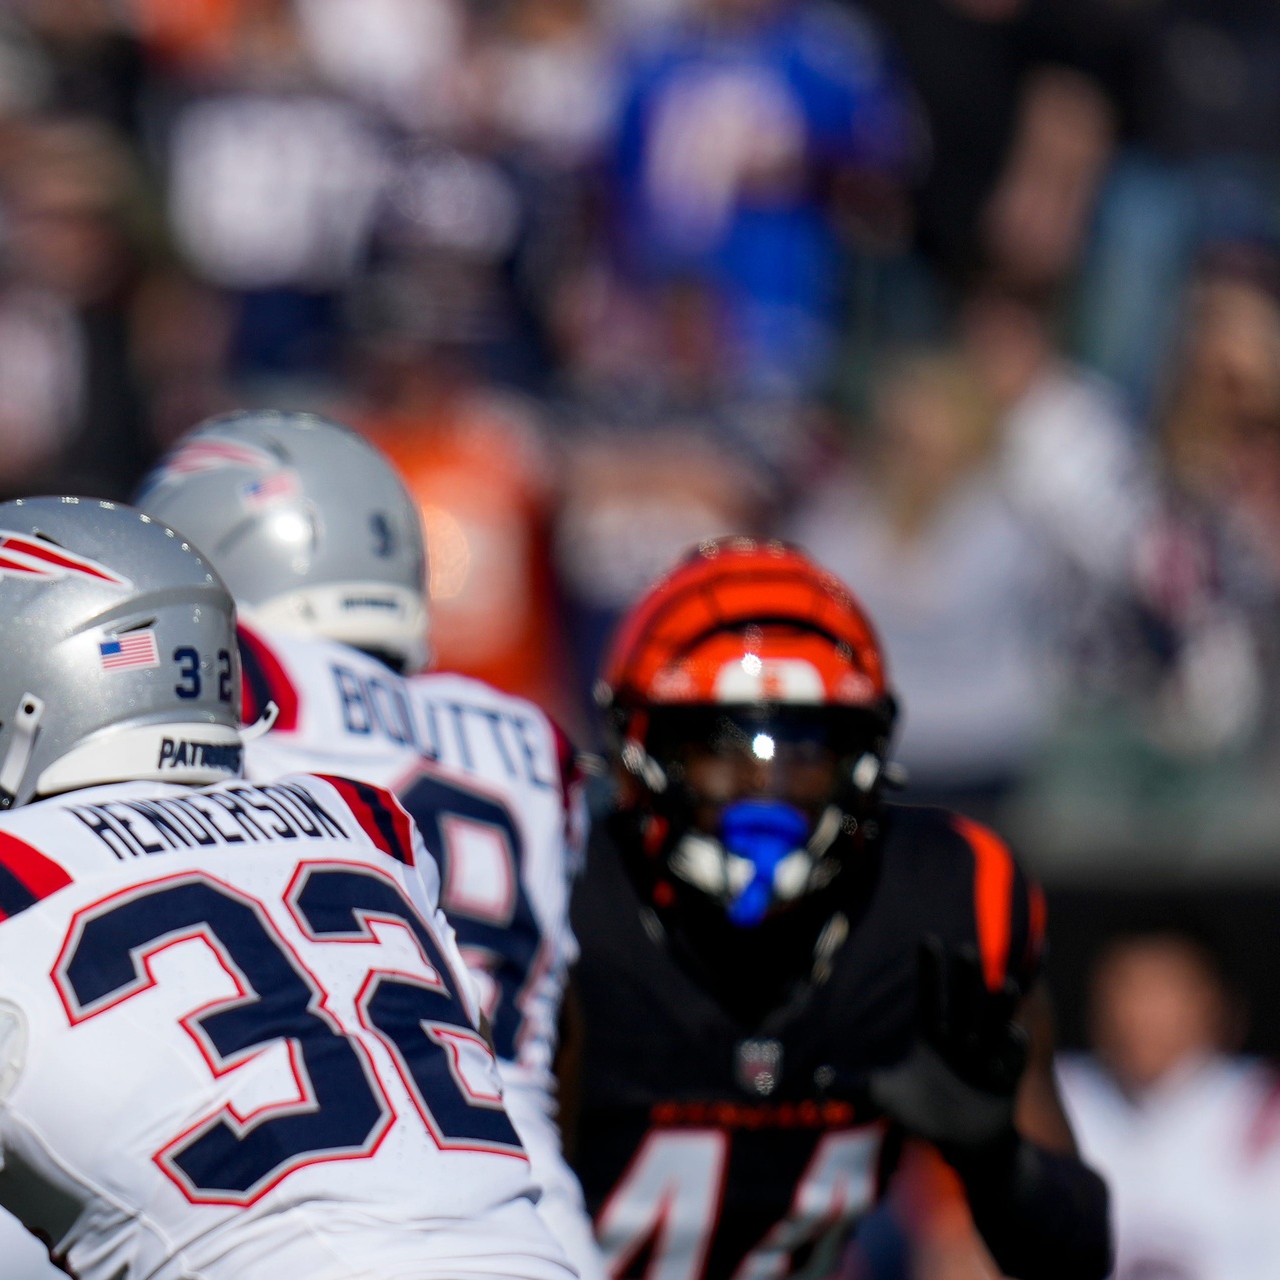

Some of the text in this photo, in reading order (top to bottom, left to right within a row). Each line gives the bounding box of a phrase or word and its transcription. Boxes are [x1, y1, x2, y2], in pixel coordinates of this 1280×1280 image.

[173, 646, 232, 702] 32
[330, 661, 554, 790] BOUTTE
[63, 783, 350, 860] HENDERSON
[50, 860, 530, 1207] 32
